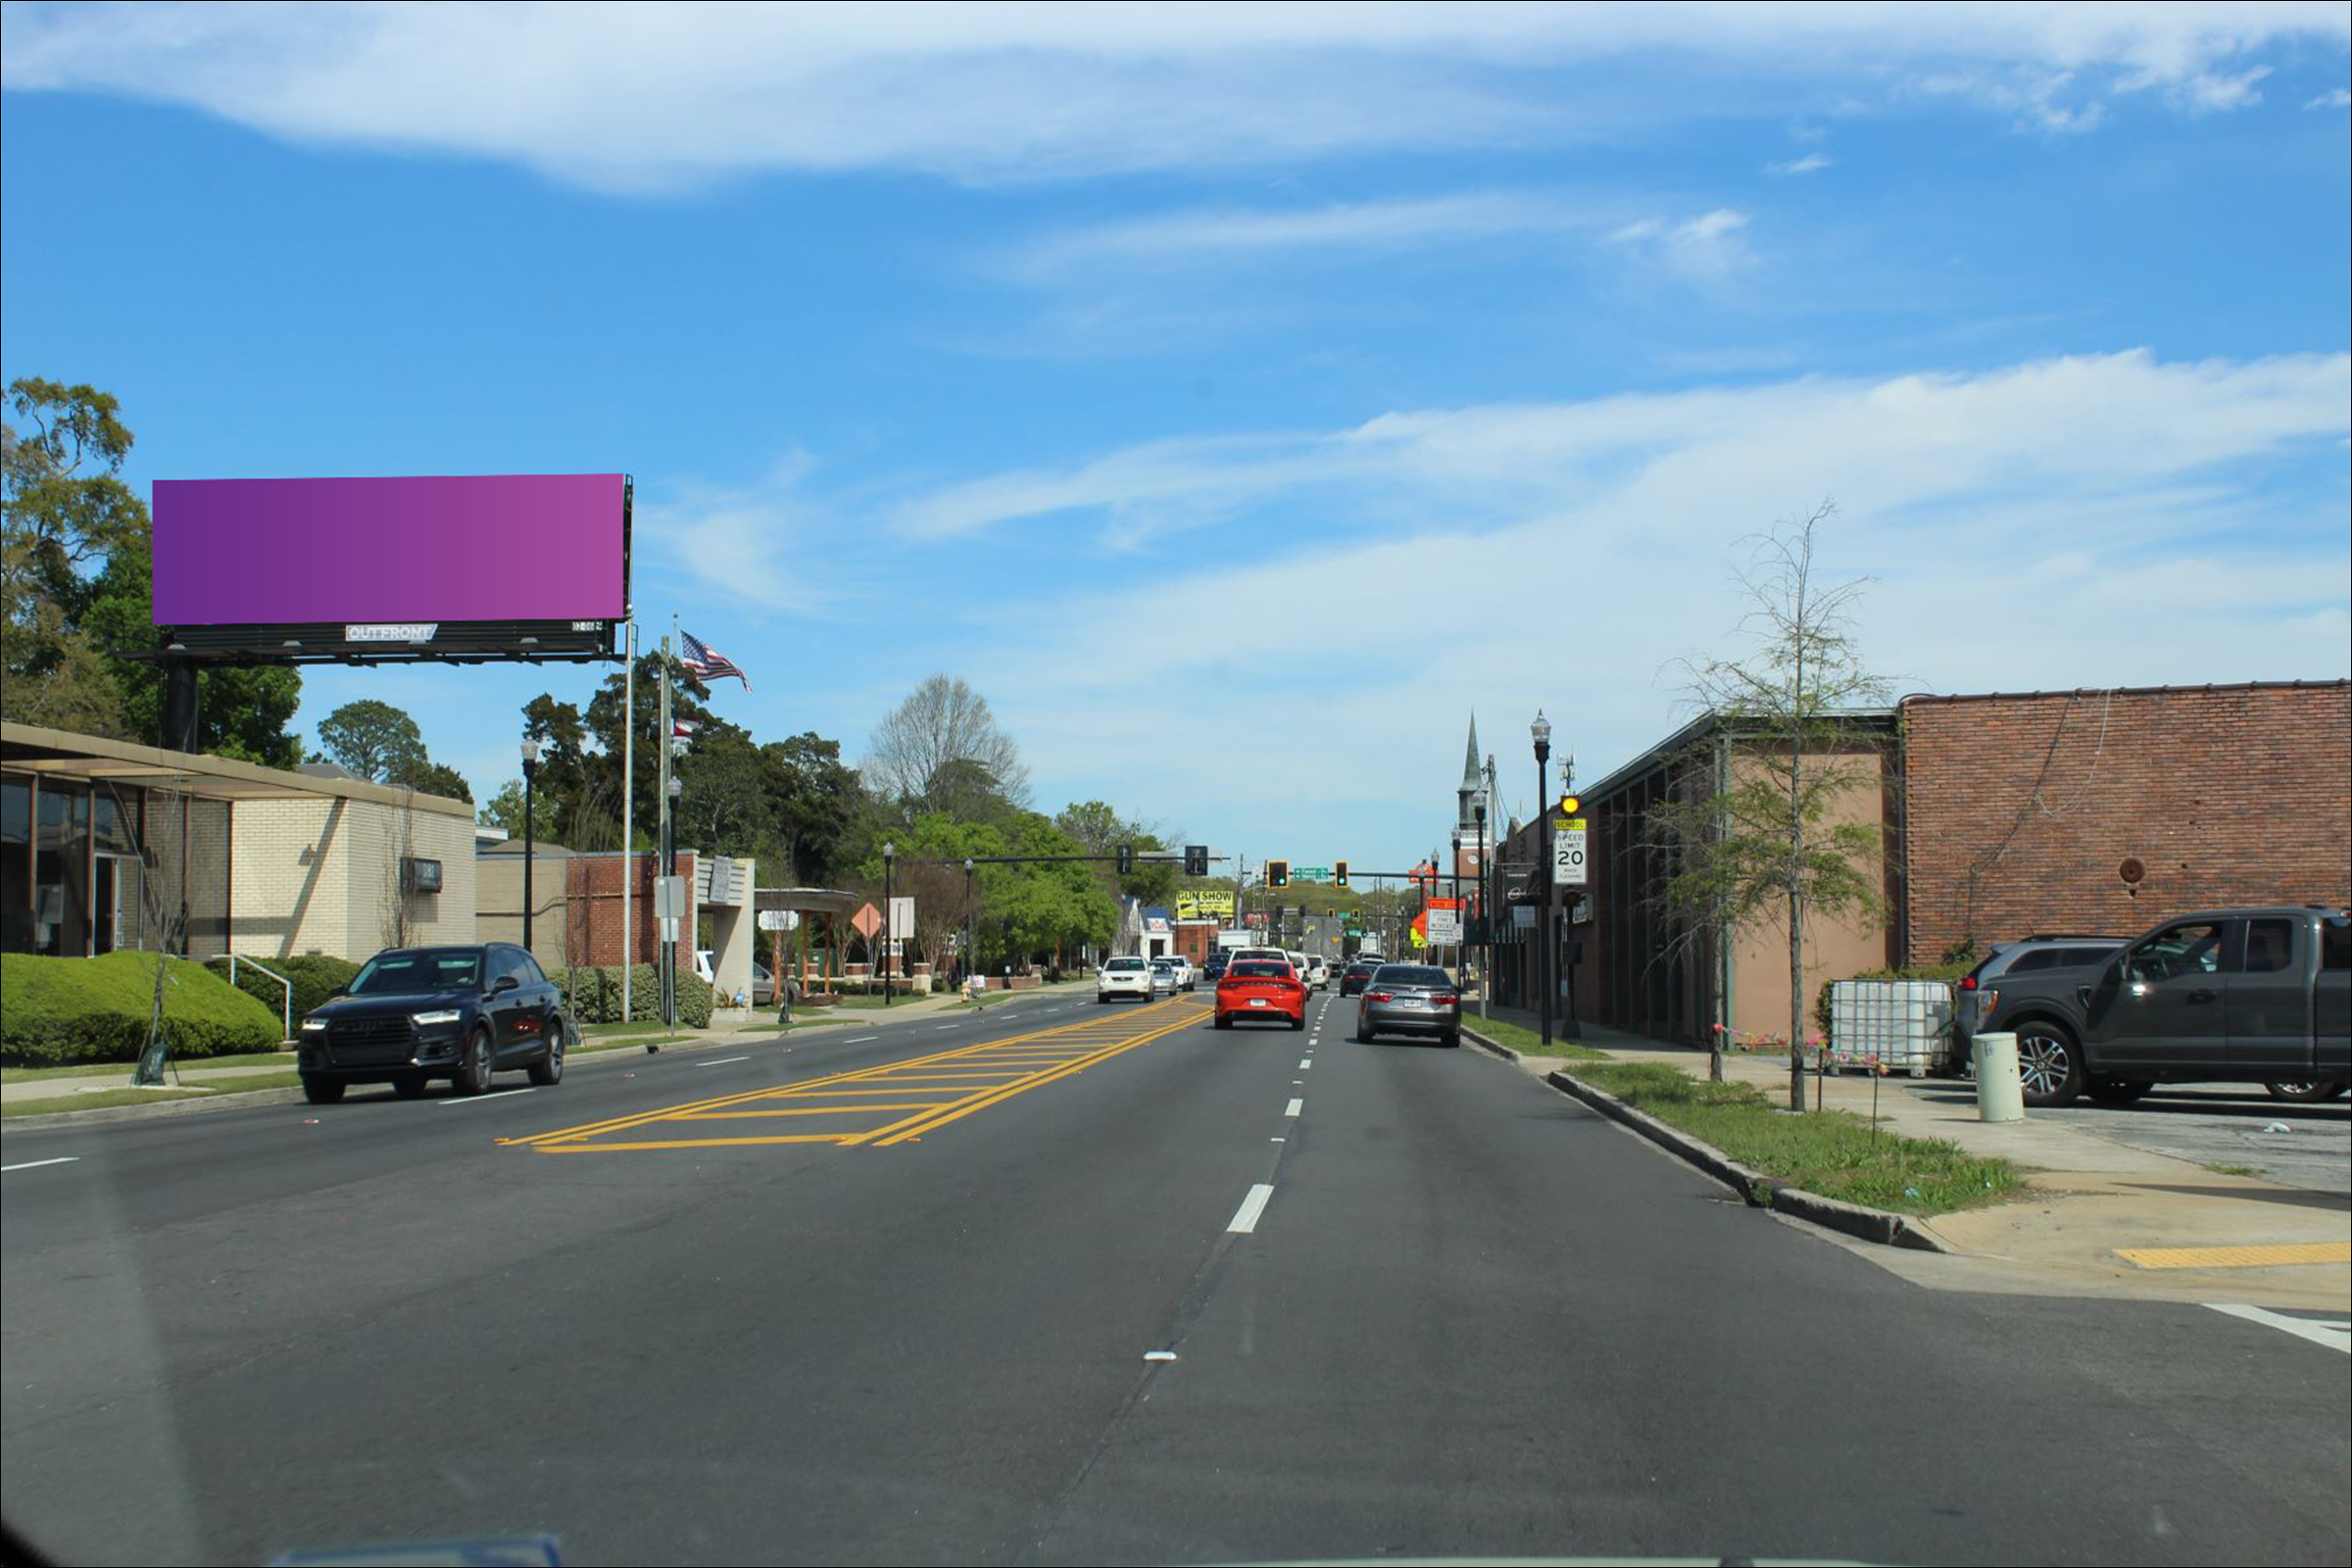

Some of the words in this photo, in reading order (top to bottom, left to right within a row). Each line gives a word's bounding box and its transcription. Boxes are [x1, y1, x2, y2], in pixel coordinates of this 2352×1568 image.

[349, 626, 432, 639] OUTFRONT
[1558, 851, 1583, 865] 20
[1177, 892, 1199, 901] GUN
[1201, 892, 1231, 901] SHOW
